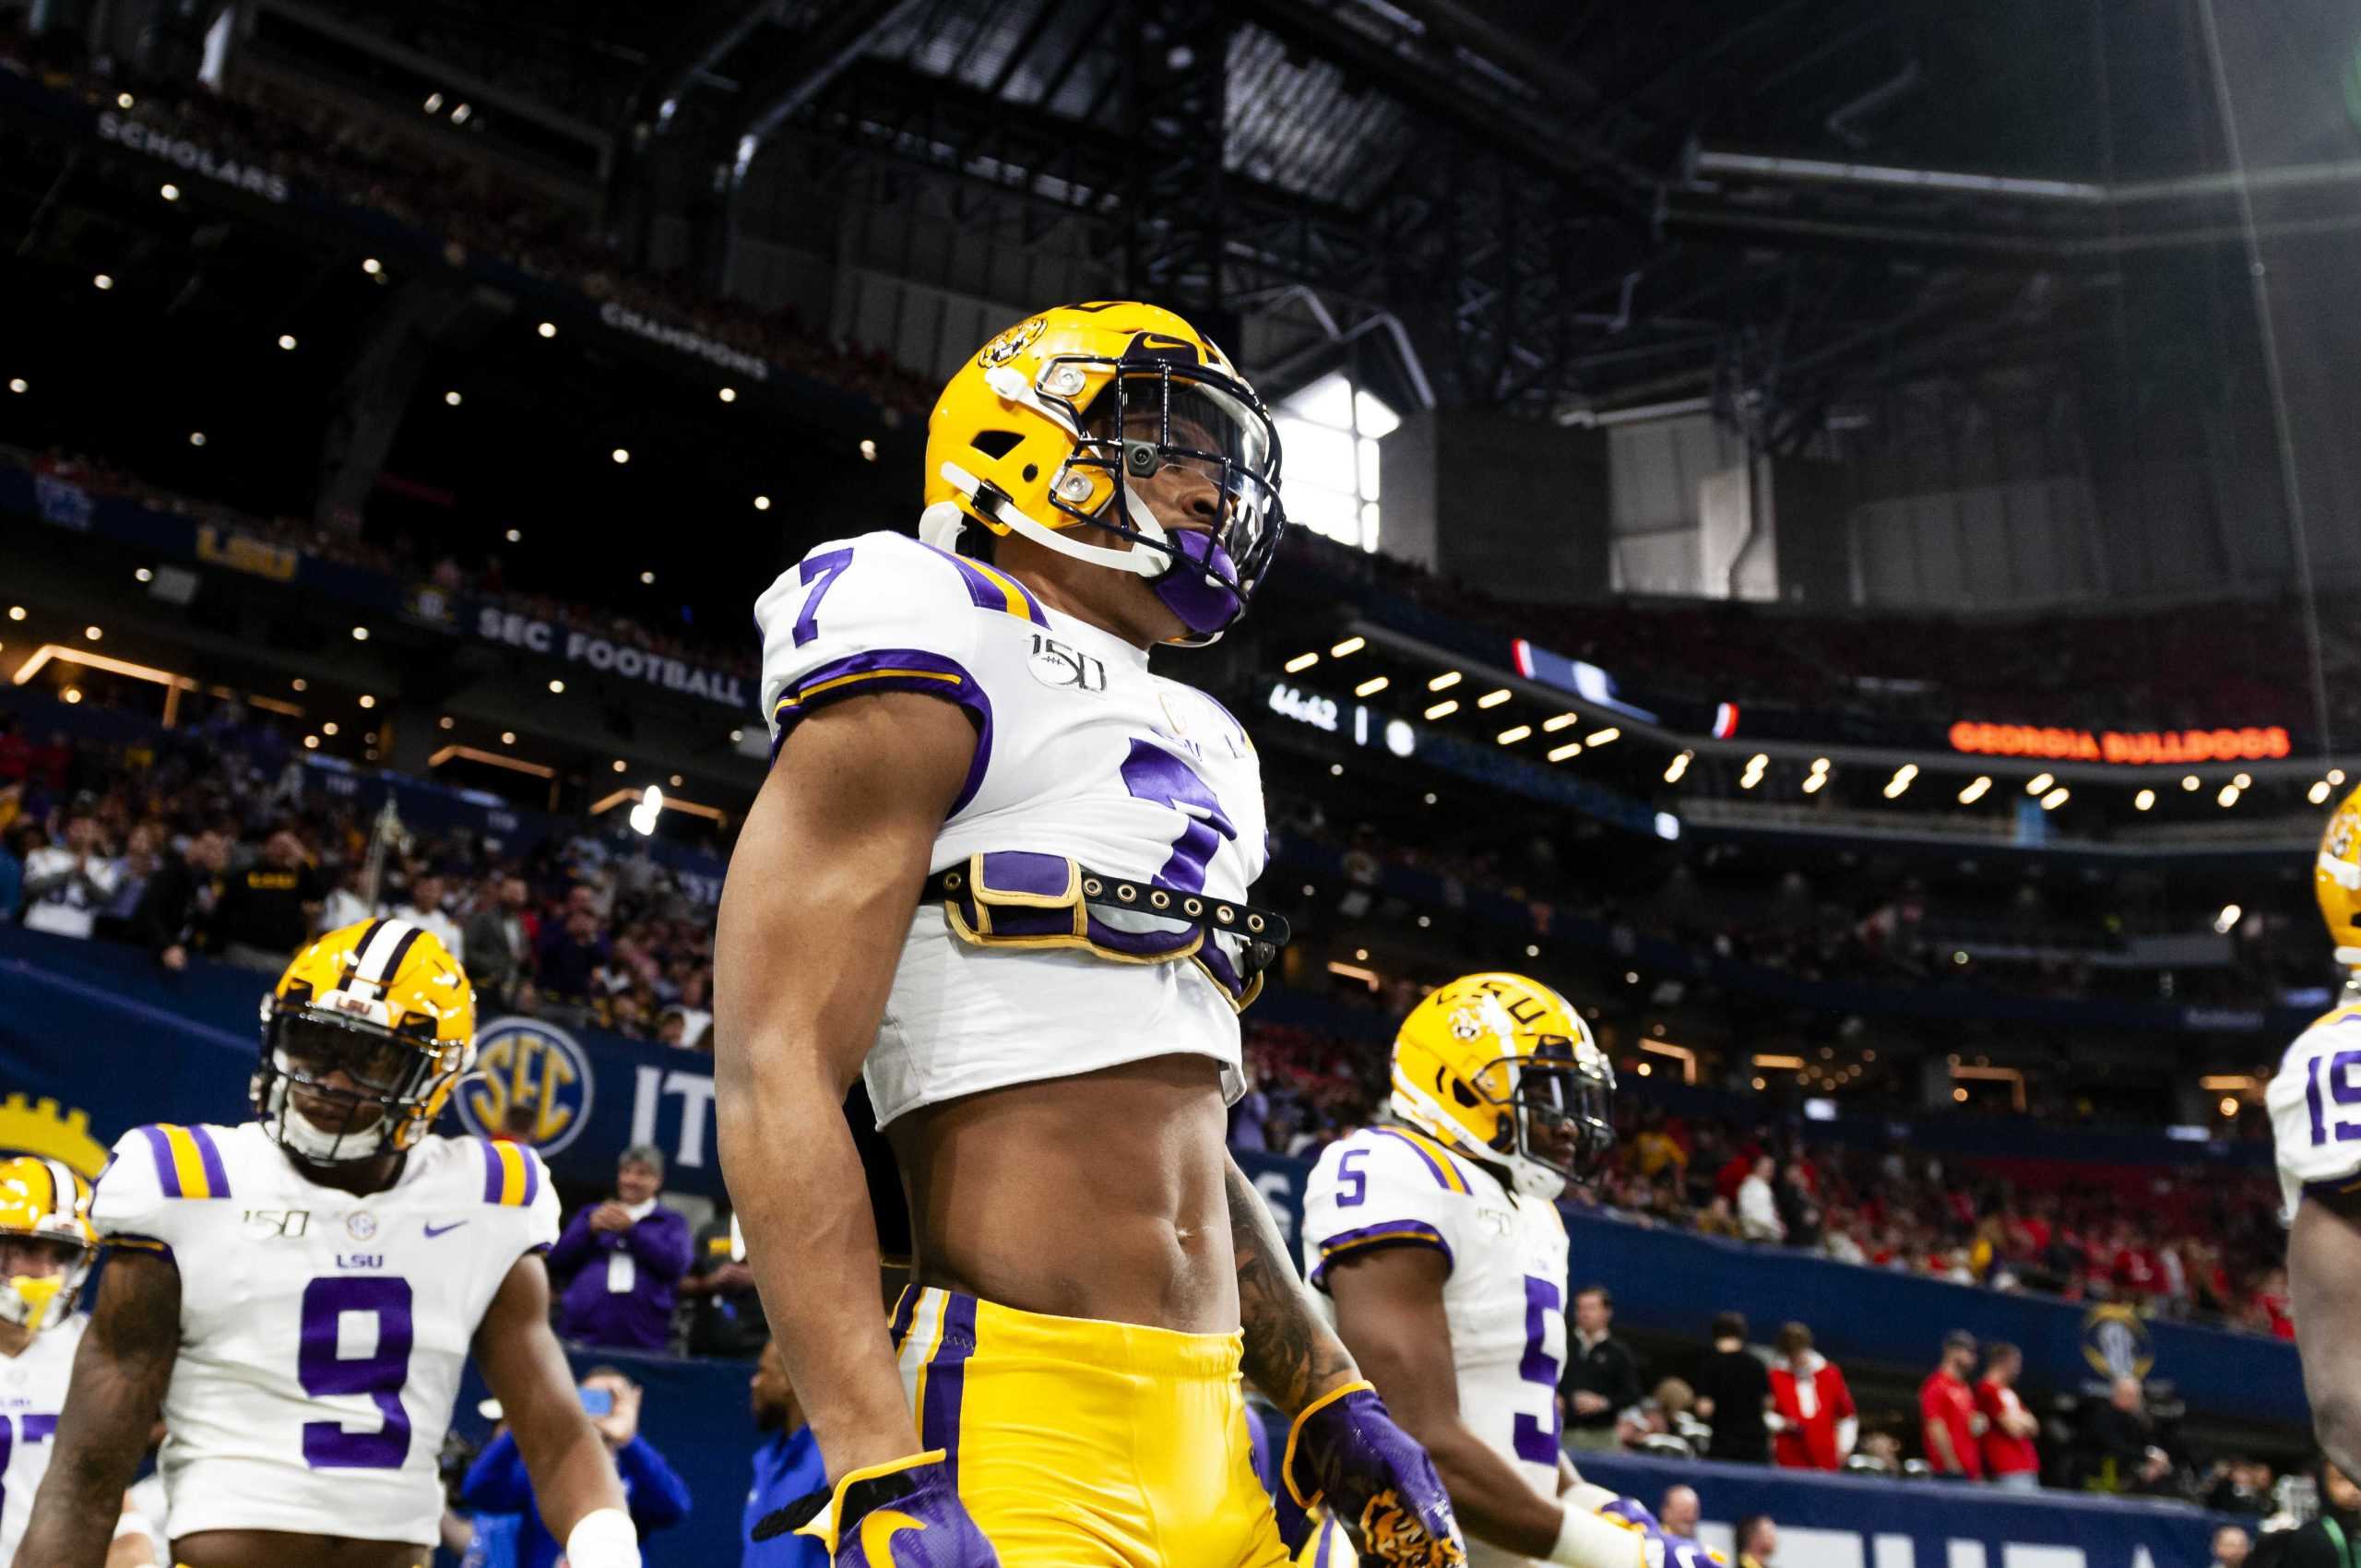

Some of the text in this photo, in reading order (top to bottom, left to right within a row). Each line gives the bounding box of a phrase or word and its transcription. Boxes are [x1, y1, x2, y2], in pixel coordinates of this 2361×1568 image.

[99, 111, 286, 204] SCHOLARS
[600, 302, 768, 381] CHAMPIONS
[792, 547, 854, 648] 7
[478, 606, 746, 707] SEC FOOTBALL
[1031, 634, 1108, 694] 150
[1949, 720, 2292, 766] GEORGIA BULLDOGS
[471, 1028, 575, 1142] SEC
[1335, 1149, 1370, 1208] 5
[336, 1253, 385, 1269] LSU
[297, 1276, 414, 1470] 9
[1513, 1274, 1561, 1468] 5
